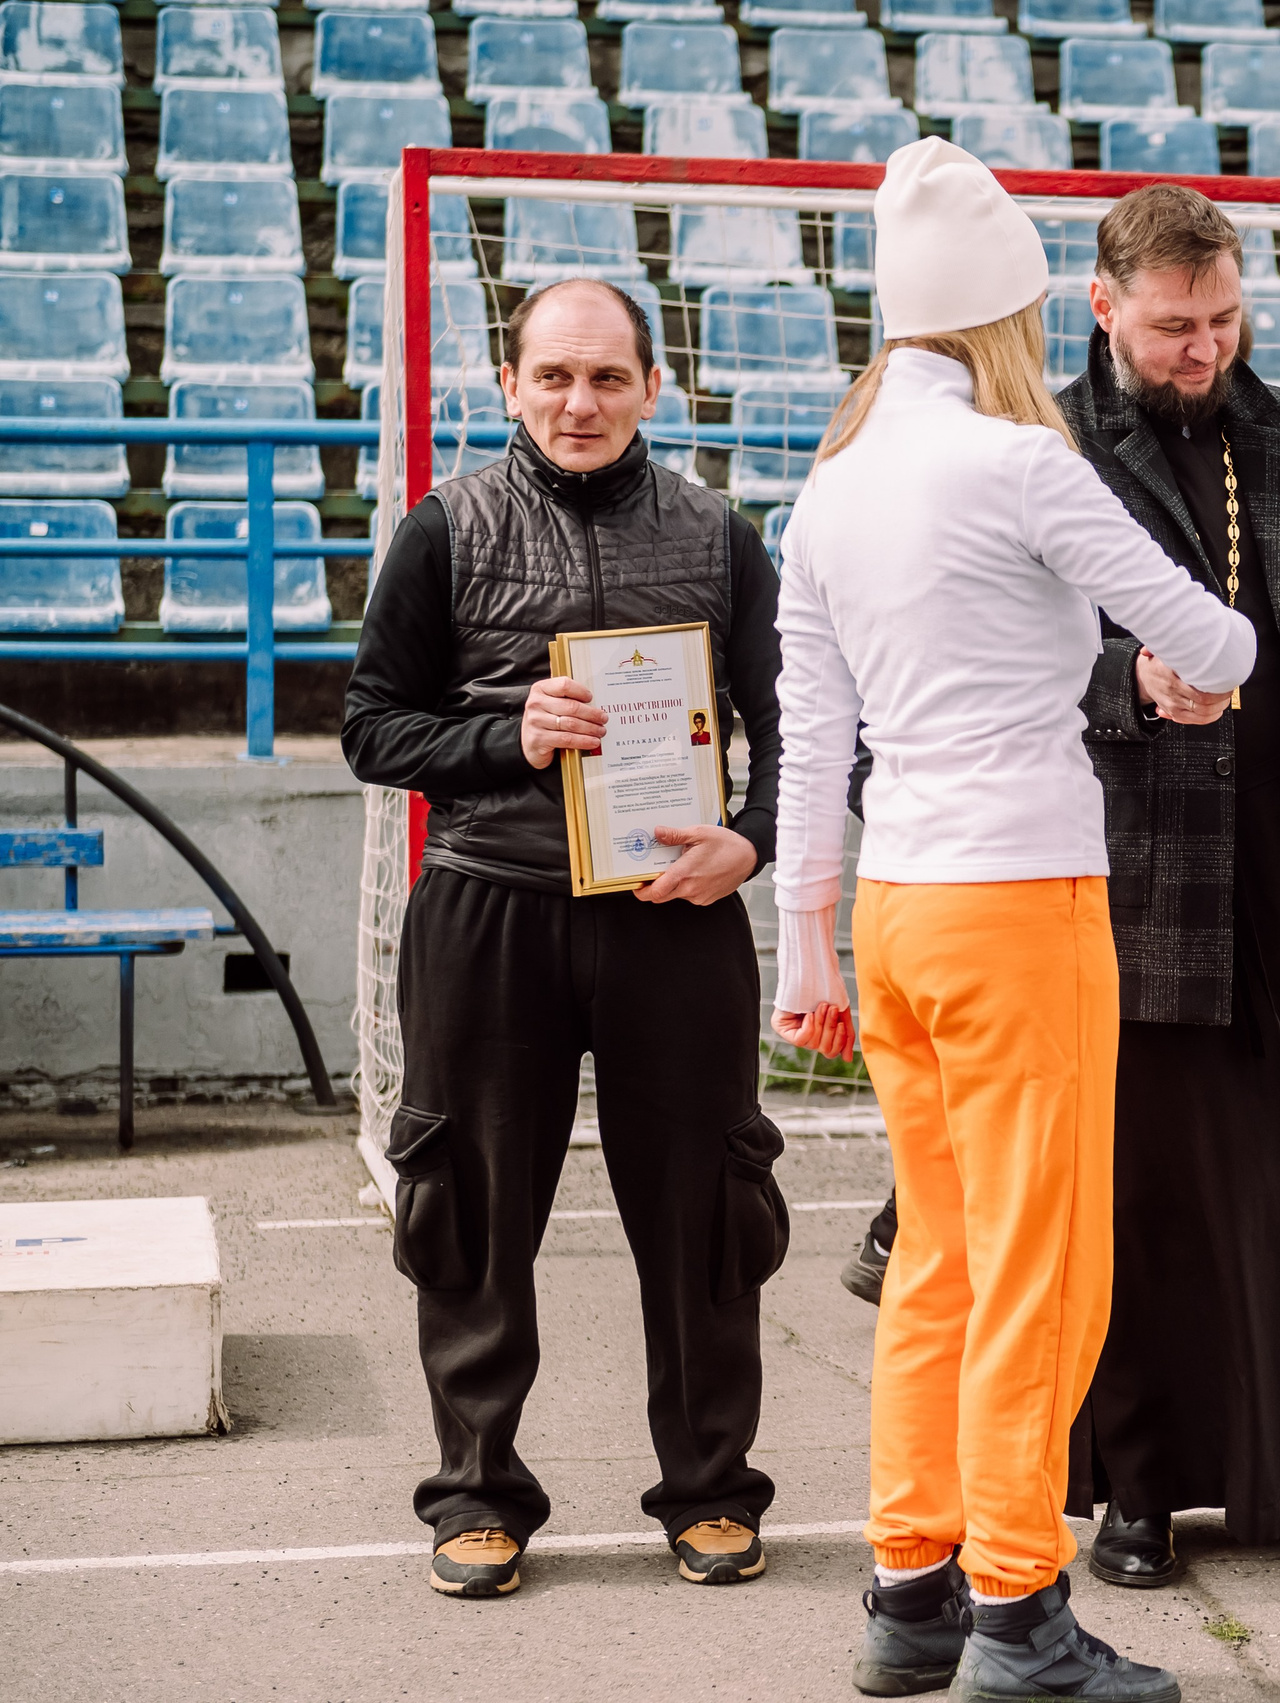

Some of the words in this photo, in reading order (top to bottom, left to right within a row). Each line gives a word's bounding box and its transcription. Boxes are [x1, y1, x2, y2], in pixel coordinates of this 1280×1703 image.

[600, 698, 684, 713] БЛАГОДАРСТВЕННОЕ
[620, 712, 668, 725] ПИСЬМО
[616, 735, 677, 747] НАГРАЖДАЕТСЯ
